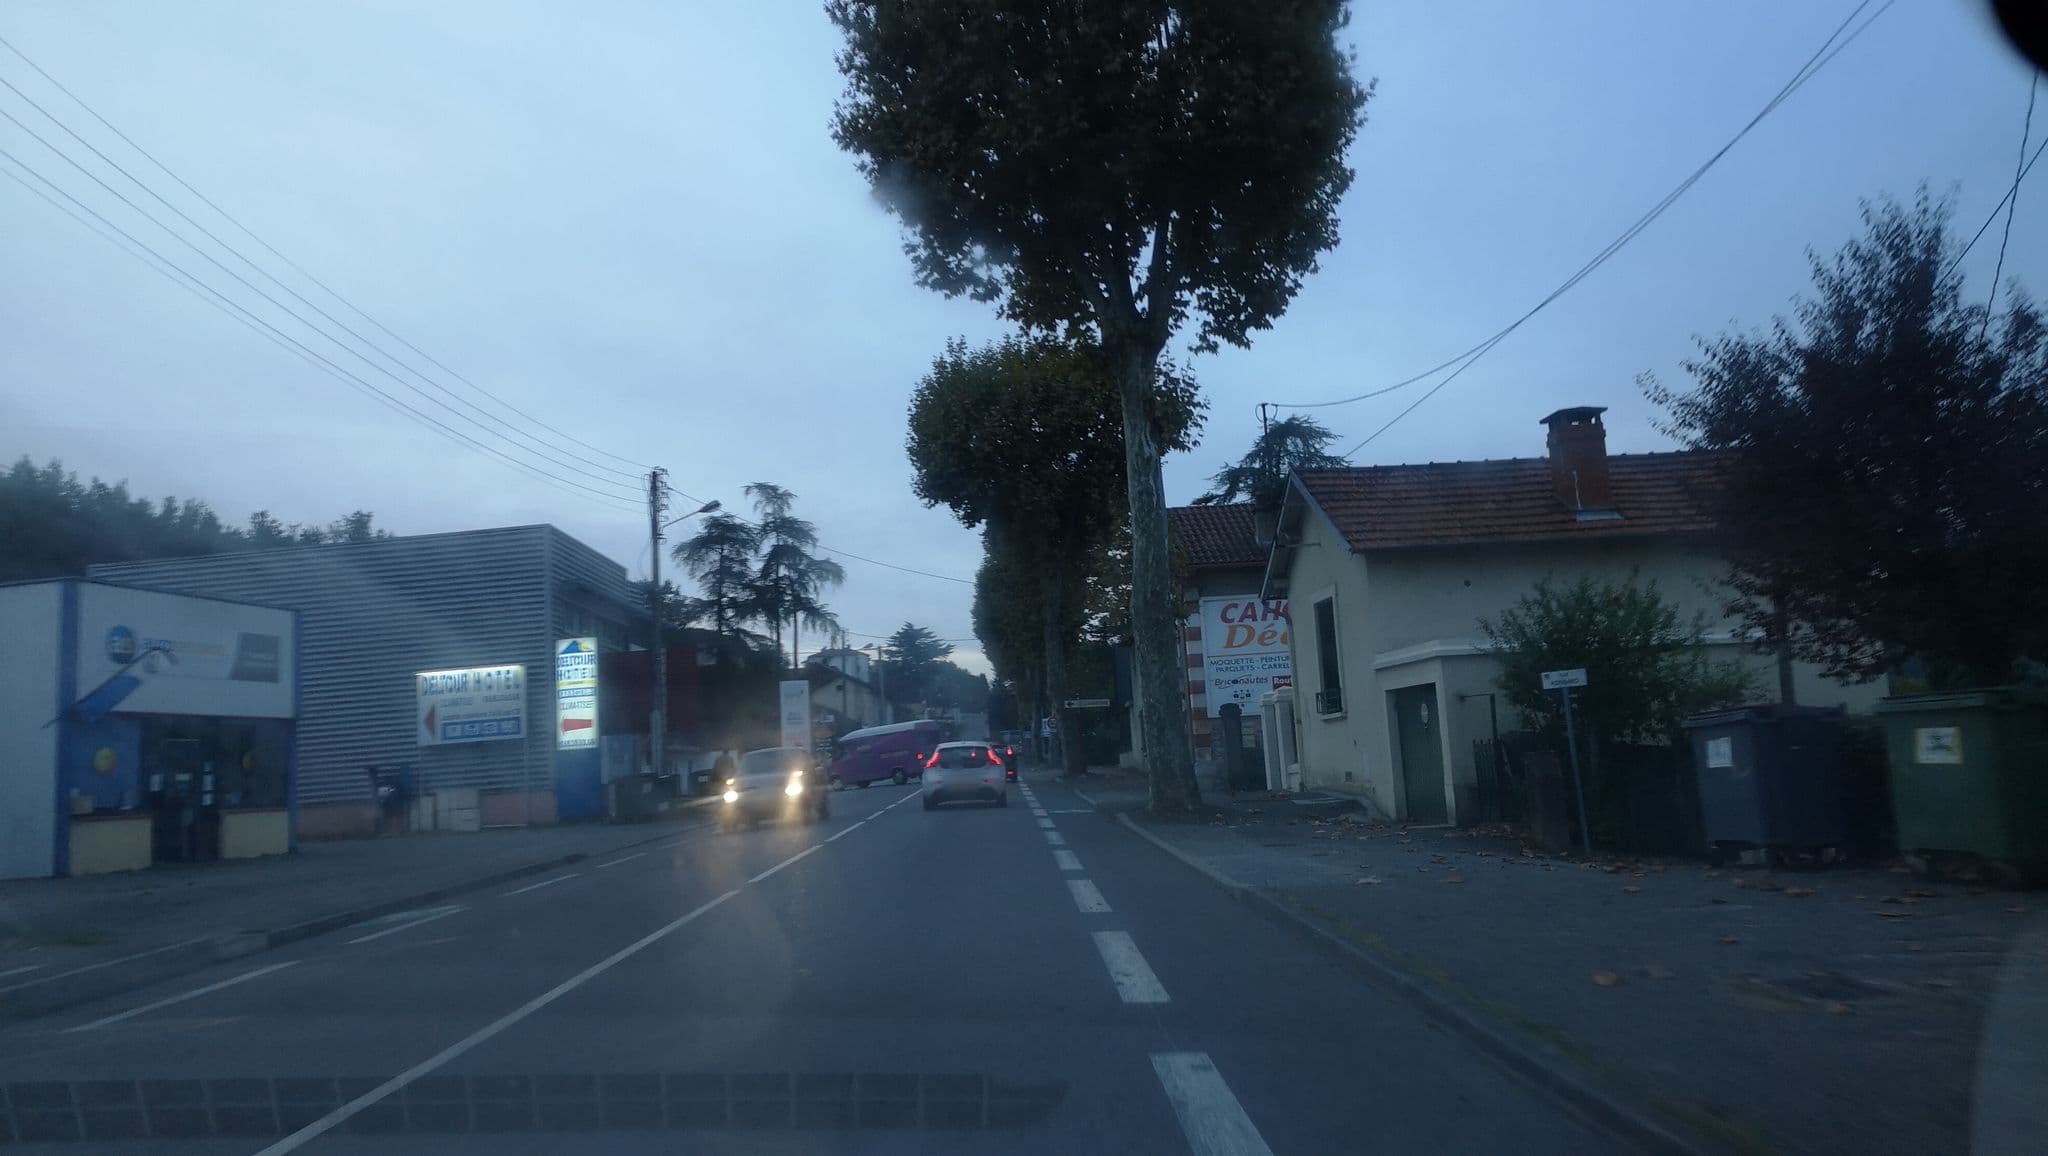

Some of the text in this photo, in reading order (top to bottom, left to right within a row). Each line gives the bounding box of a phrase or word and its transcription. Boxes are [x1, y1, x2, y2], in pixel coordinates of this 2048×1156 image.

[1210, 657, 1255, 666] MOQUETTE
[556, 667, 597, 681] HOTEL
[1216, 664, 1255, 673] PARQUETS
[473, 669, 520, 691] HOTEL
[1214, 675, 1268, 687] Briconautes
